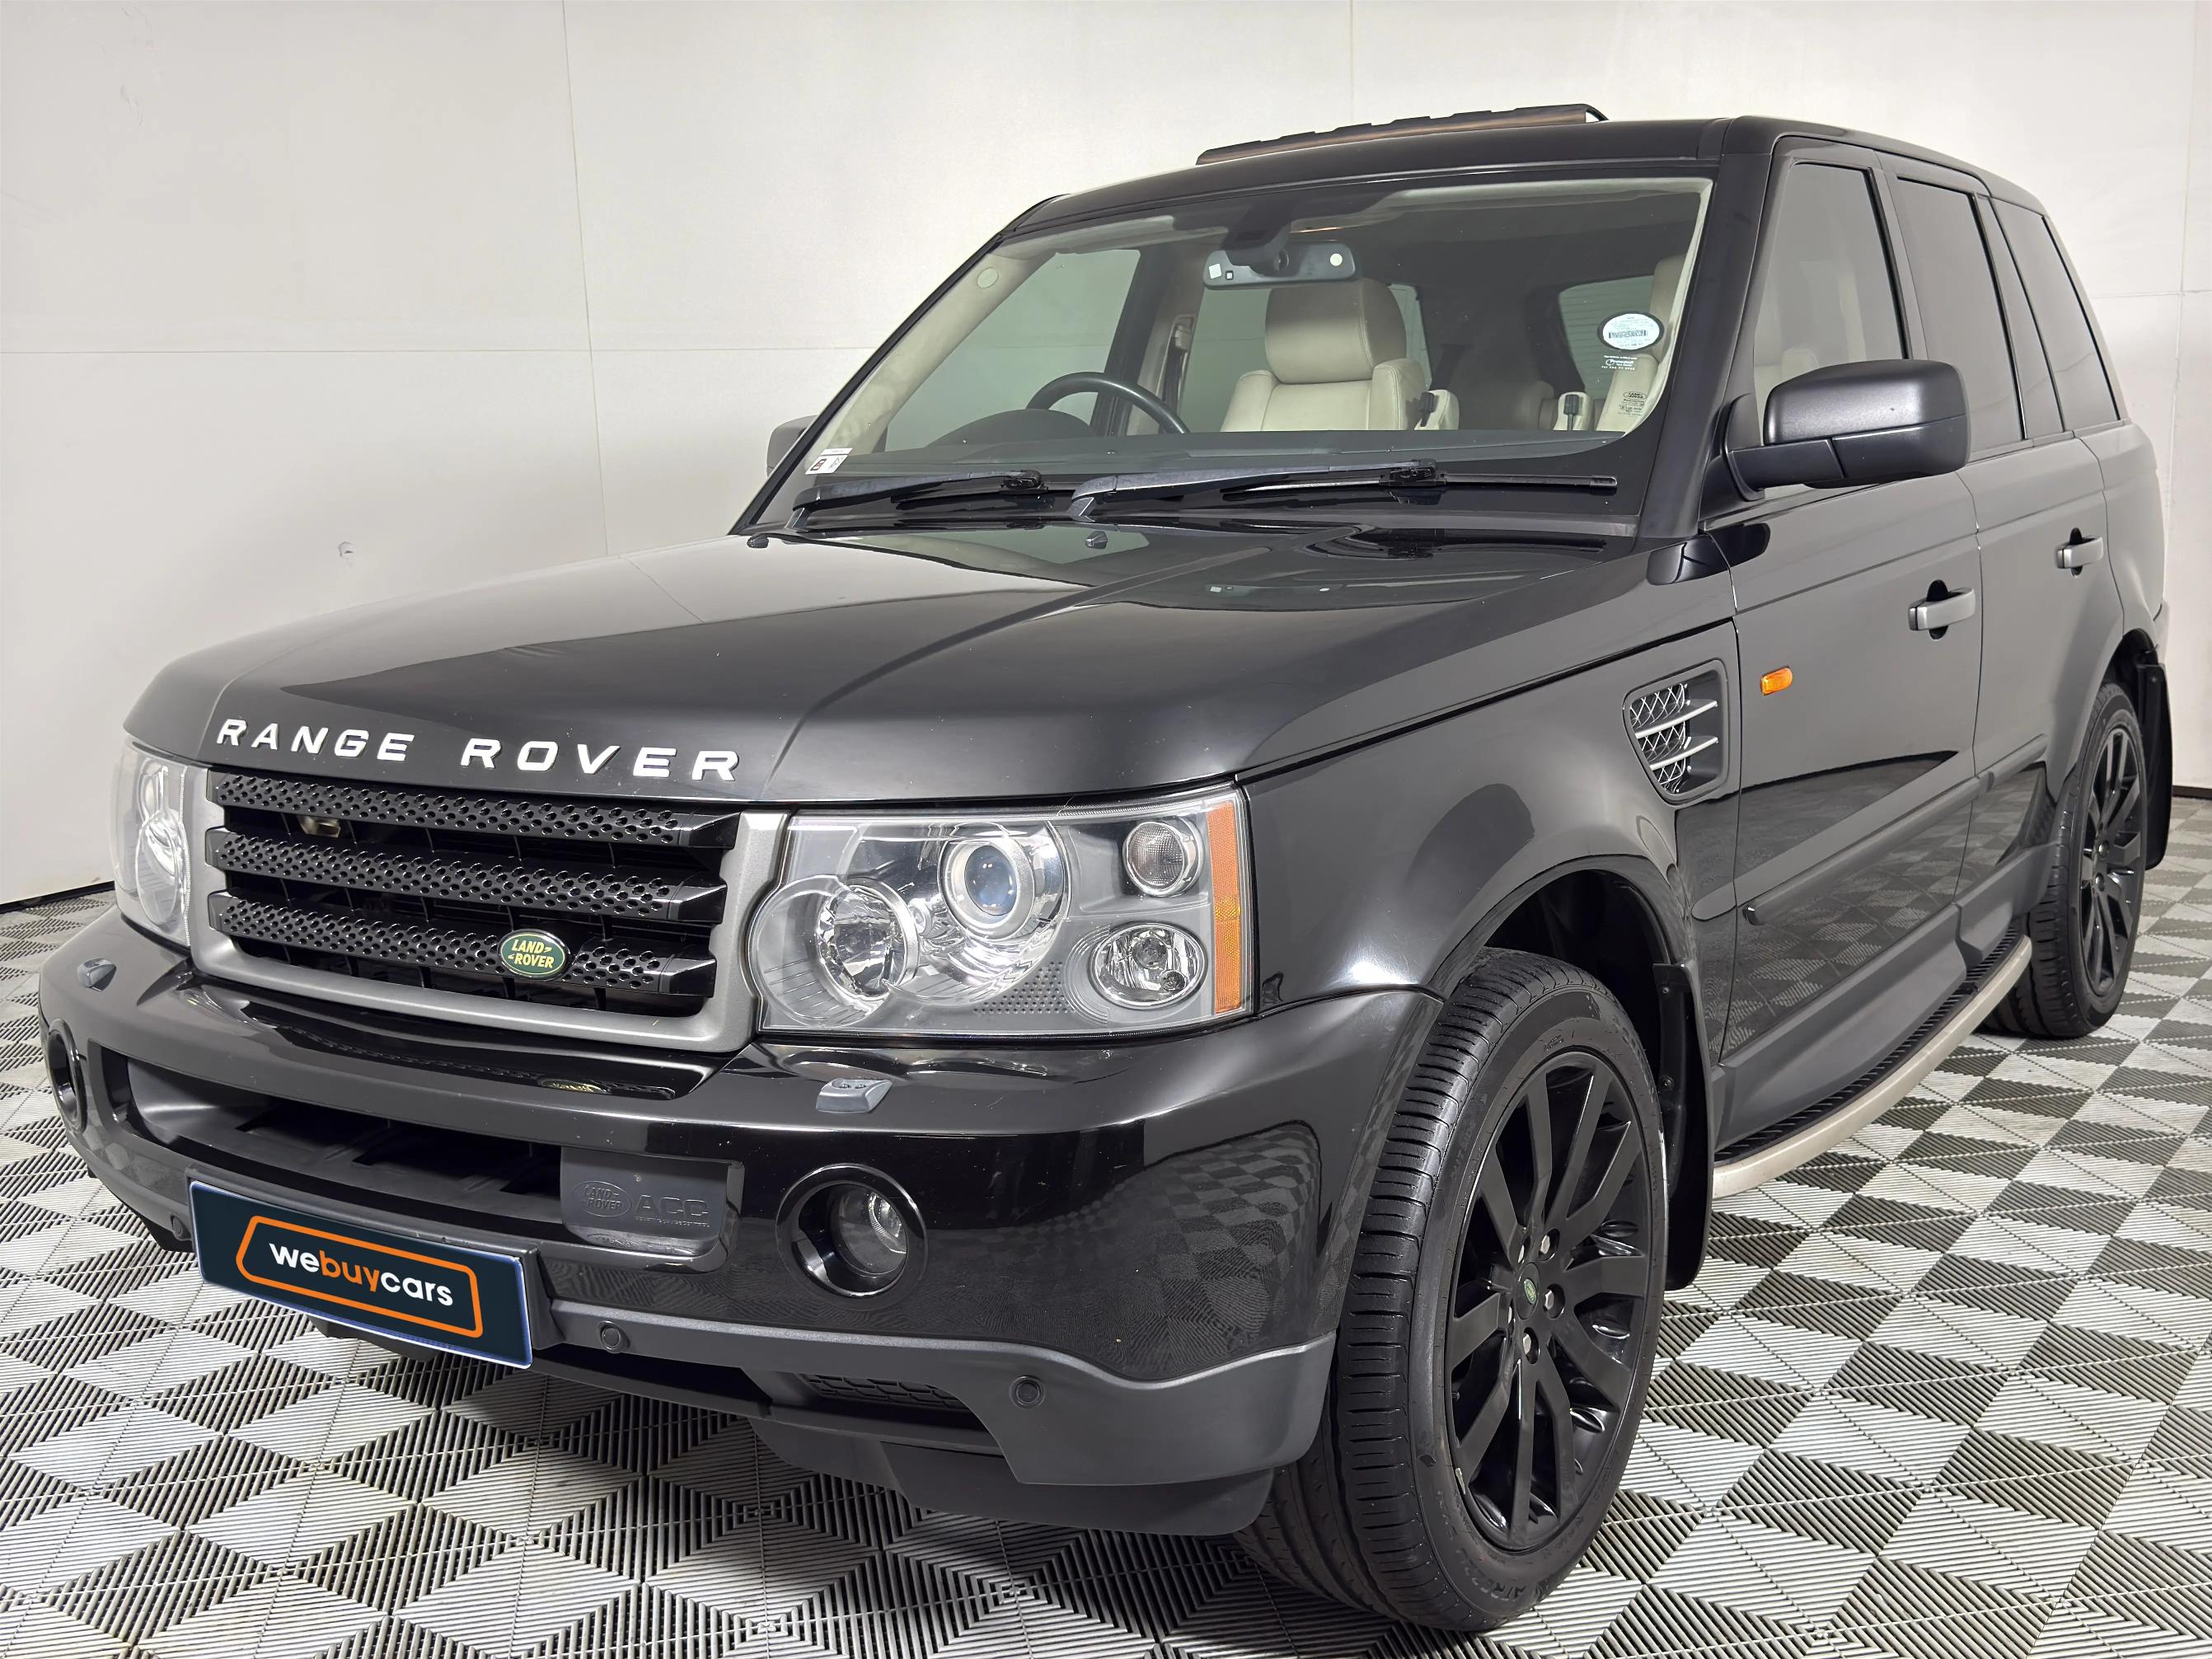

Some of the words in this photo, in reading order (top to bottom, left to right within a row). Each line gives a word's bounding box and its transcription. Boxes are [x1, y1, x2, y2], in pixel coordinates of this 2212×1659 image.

[218, 718, 414, 762] RANGE
[461, 738, 739, 781] ROVER
[512, 939, 545, 954] LAND
[514, 953, 555, 968] ROVER
[584, 1185, 612, 1200] LAND
[587, 1197, 622, 1211] ROVER
[633, 1194, 710, 1220] ACC
[269, 1241, 454, 1307] webuycars
